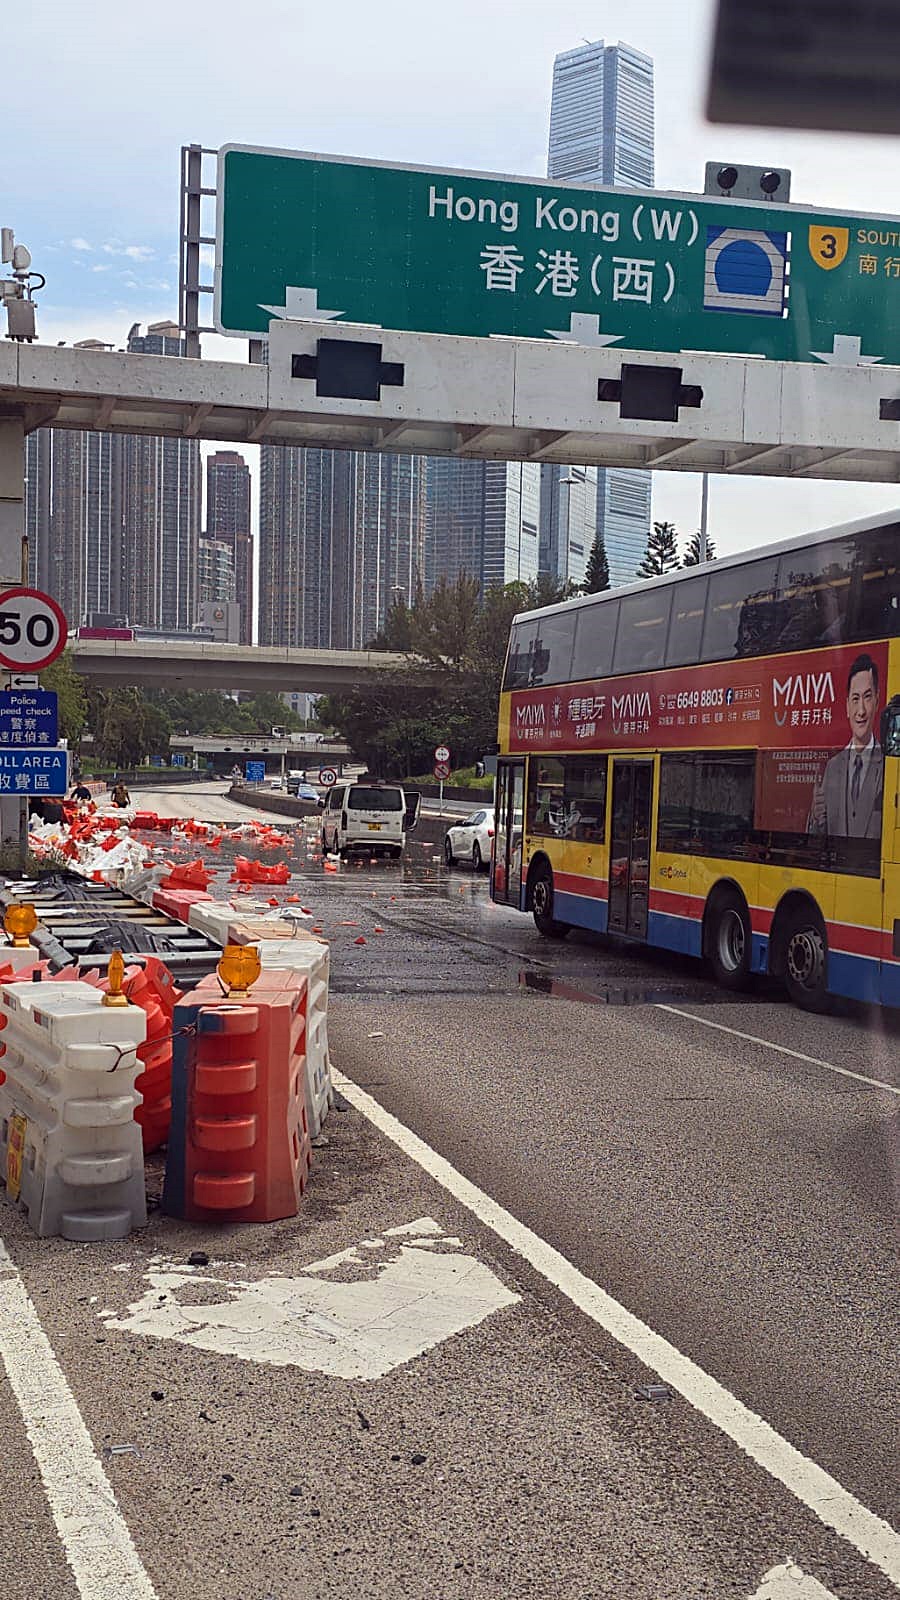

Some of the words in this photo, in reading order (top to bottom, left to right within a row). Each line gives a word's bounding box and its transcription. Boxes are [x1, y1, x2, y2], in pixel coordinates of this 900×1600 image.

[428, 186, 518, 231] Hong
[535, 198, 620, 240] Kong
[633, 205, 700, 247] (W)
[820, 234, 837, 259] 3
[857, 229, 900, 247] SOUT
[859, 254, 900, 278] 南行
[0, 612, 54, 648] 50
[10, 694, 37, 705] Police
[677, 691, 700, 709] 6649
[700, 688, 723, 707] 8803
[773, 672, 835, 707] MAIYA
[25, 707, 52, 715] check
[516, 704, 545, 725] MAIYA
[612, 692, 652, 719] MAIYA
[11, 718, 37, 730] 警察
[0, 756, 19, 768] LL
[22, 756, 61, 768] AREA
